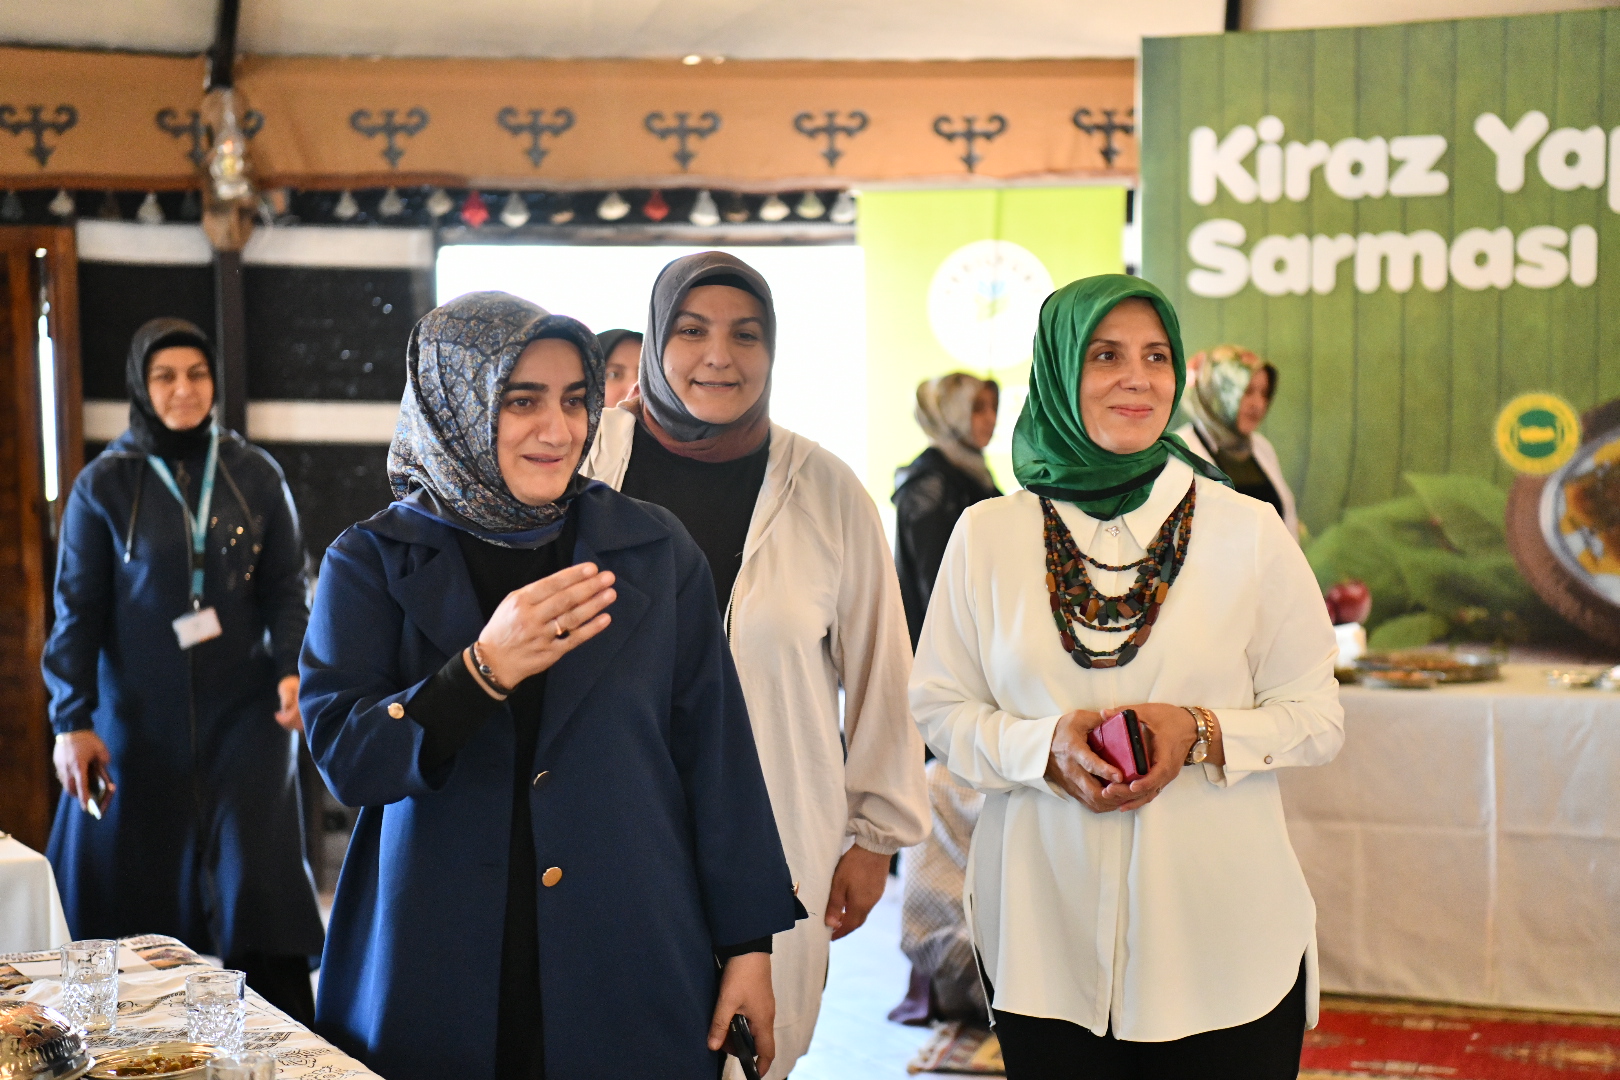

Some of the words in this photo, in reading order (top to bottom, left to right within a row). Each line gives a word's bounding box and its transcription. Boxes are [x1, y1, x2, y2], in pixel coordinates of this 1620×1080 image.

[1188, 115, 1449, 205] Kiraz
[1475, 111, 1620, 213] Ya
[1186, 218, 1598, 298] Sarması
